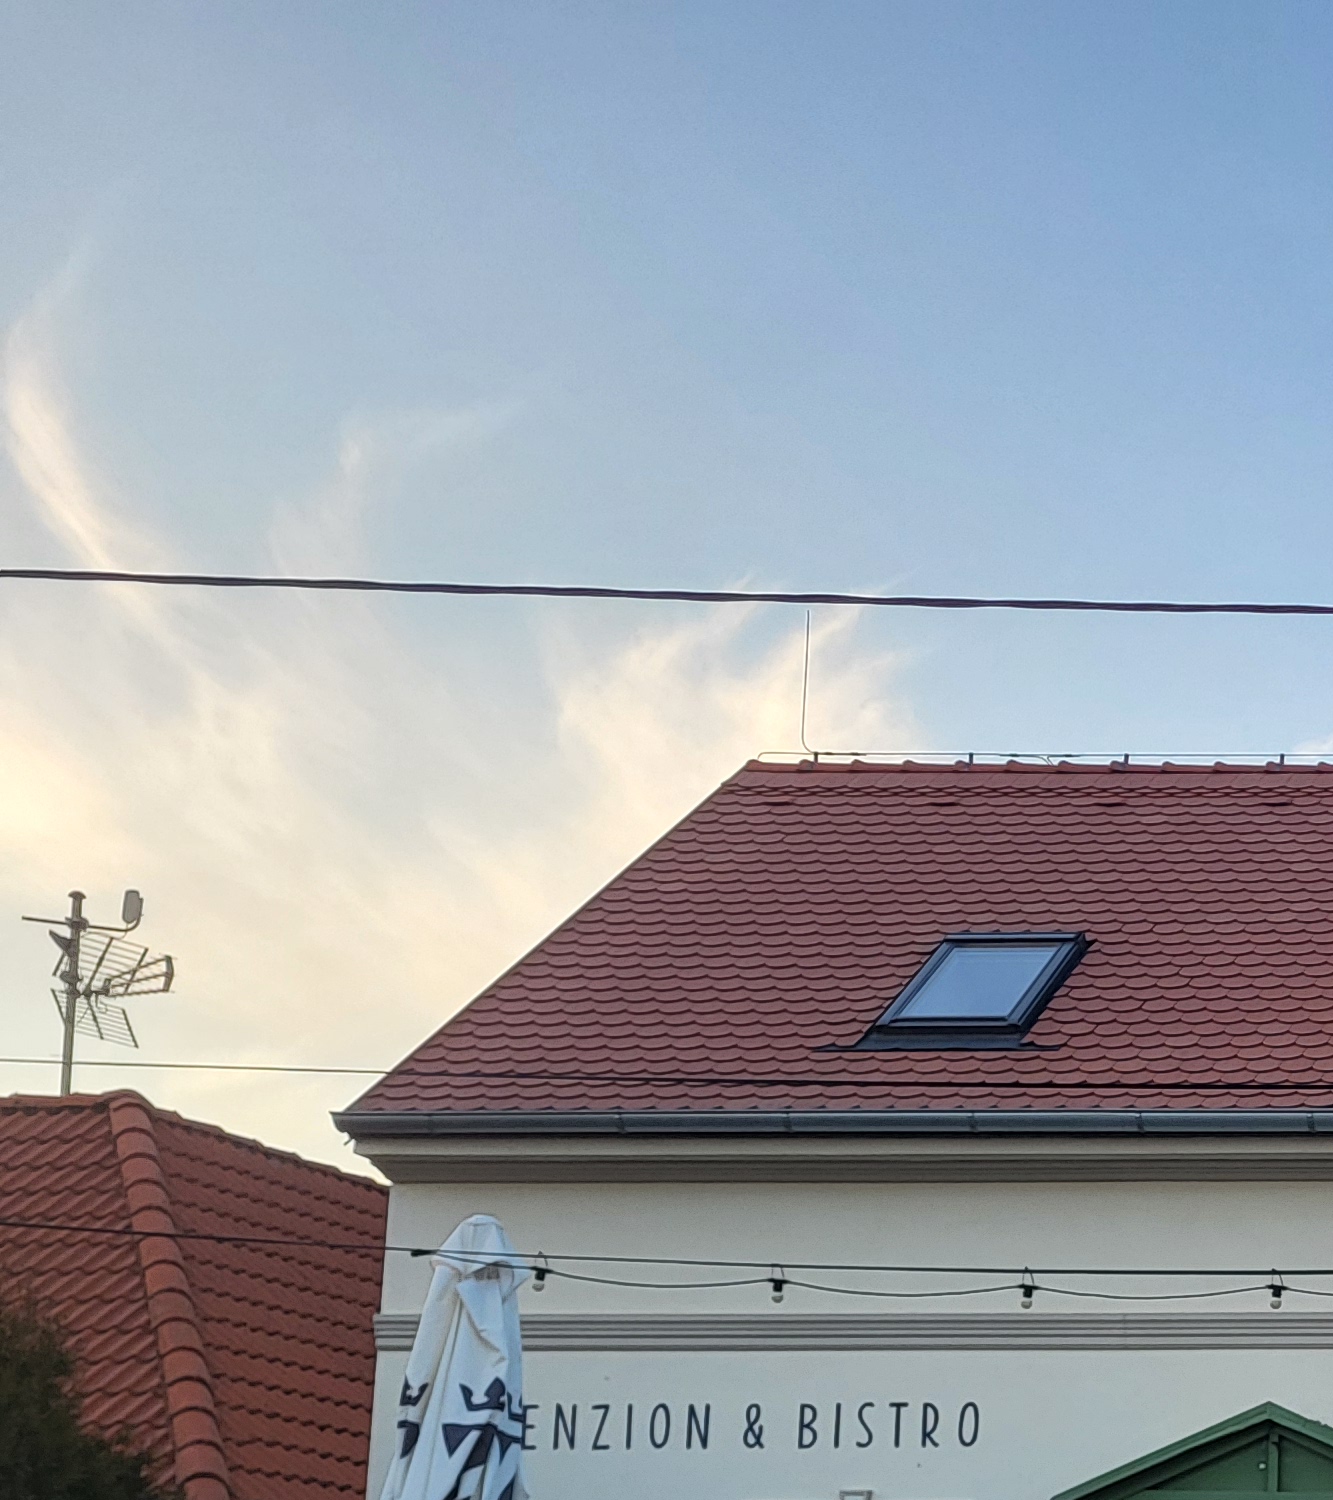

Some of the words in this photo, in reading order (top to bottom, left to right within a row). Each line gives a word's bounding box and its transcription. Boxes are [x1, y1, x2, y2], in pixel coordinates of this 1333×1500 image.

[520, 1403, 712, 1451] ENZION
[742, 1402, 766, 1450] &
[798, 1402, 981, 1451] BISTRO
